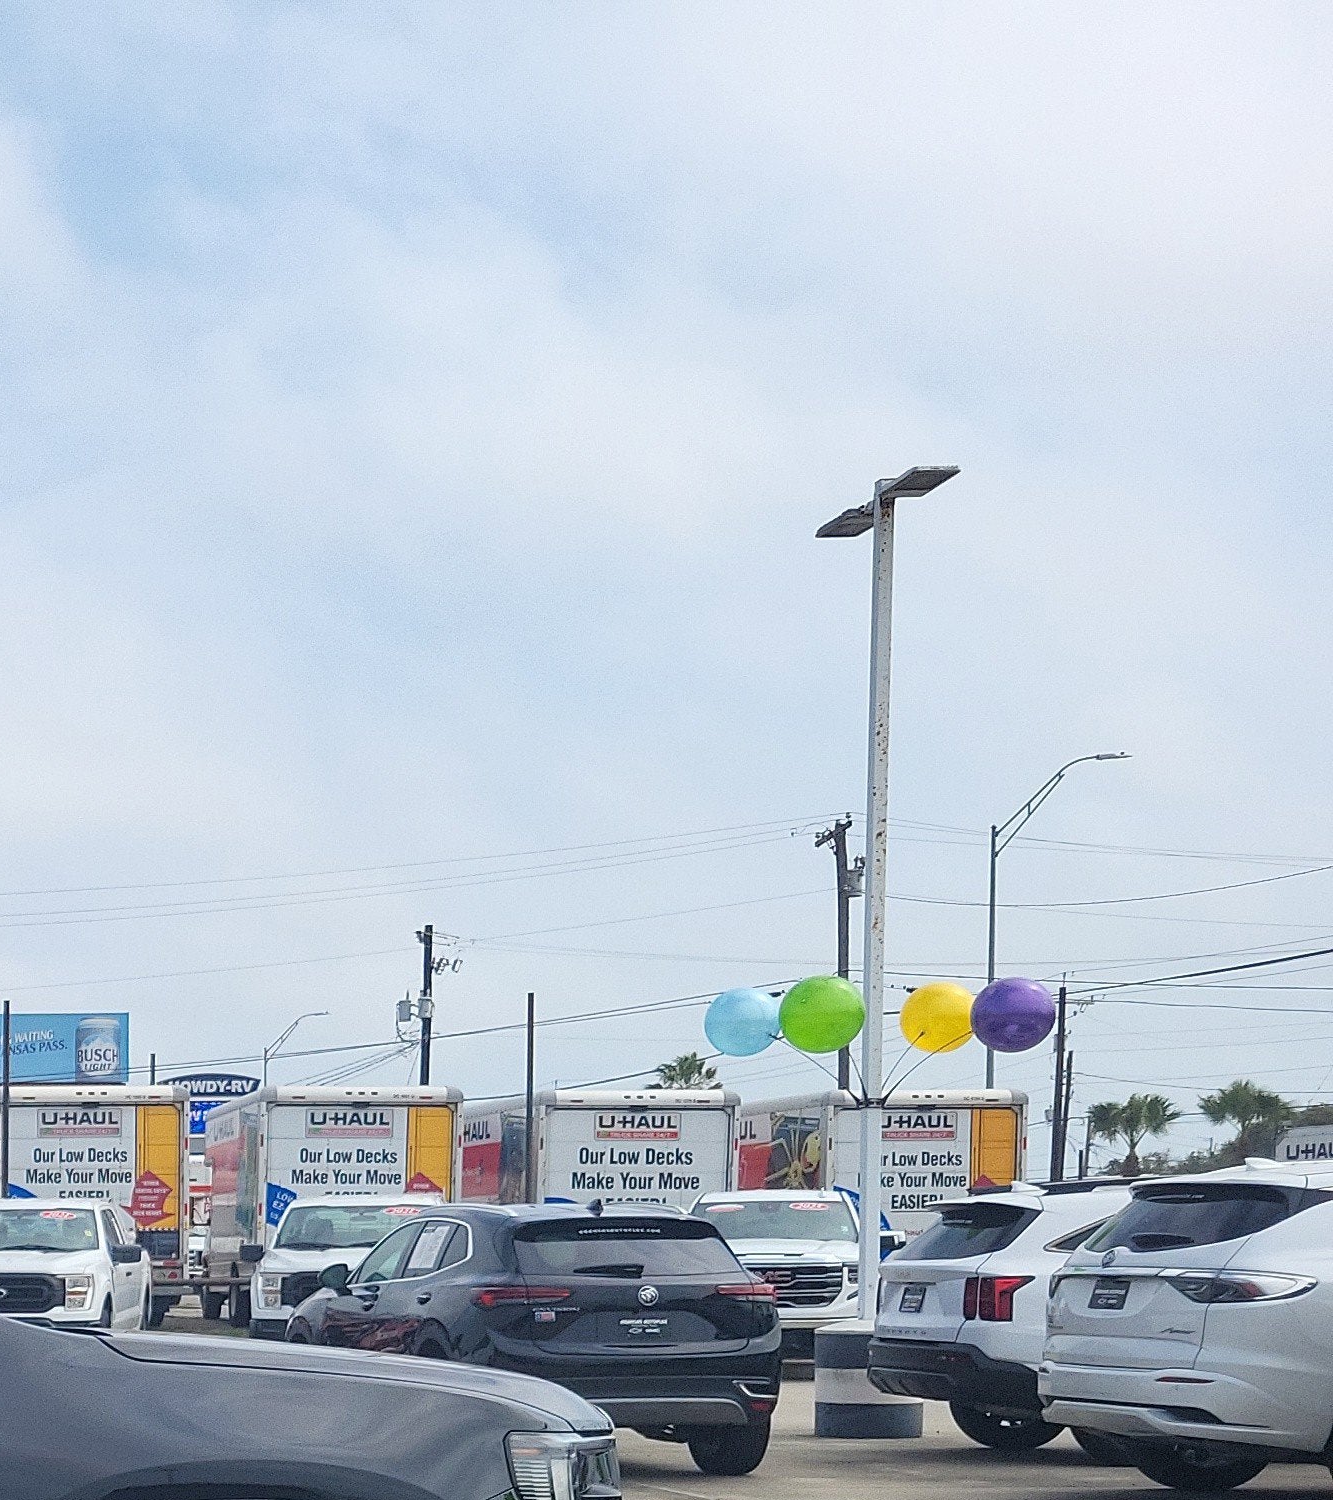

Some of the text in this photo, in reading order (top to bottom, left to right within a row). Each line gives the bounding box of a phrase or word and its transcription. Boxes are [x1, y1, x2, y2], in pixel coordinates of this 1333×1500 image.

[15, 1029, 54, 1043] WAITING
[39, 1039, 68, 1053] PASS.
[77, 1048, 119, 1063] BUSCH
[84, 1063, 112, 1071] LIGHT
[41, 1111, 119, 1125] U-HAUL
[310, 1112, 390, 1126] U-HAUL
[598, 1115, 678, 1129] U-HAUL
[33, 1148, 128, 1164] Our Low Decks
[299, 1148, 398, 1164] Our Low Decks
[578, 1147, 693, 1166] Our Low Decks
[891, 1152, 918, 1167] Low
[921, 1151, 963, 1167] Decks
[26, 1169, 132, 1184] Make Your Move
[290, 1169, 402, 1185] Make Your Move
[571, 1172, 700, 1190] Make Your Move
[899, 1172, 929, 1188] Your
[932, 1172, 967, 1188] Move
